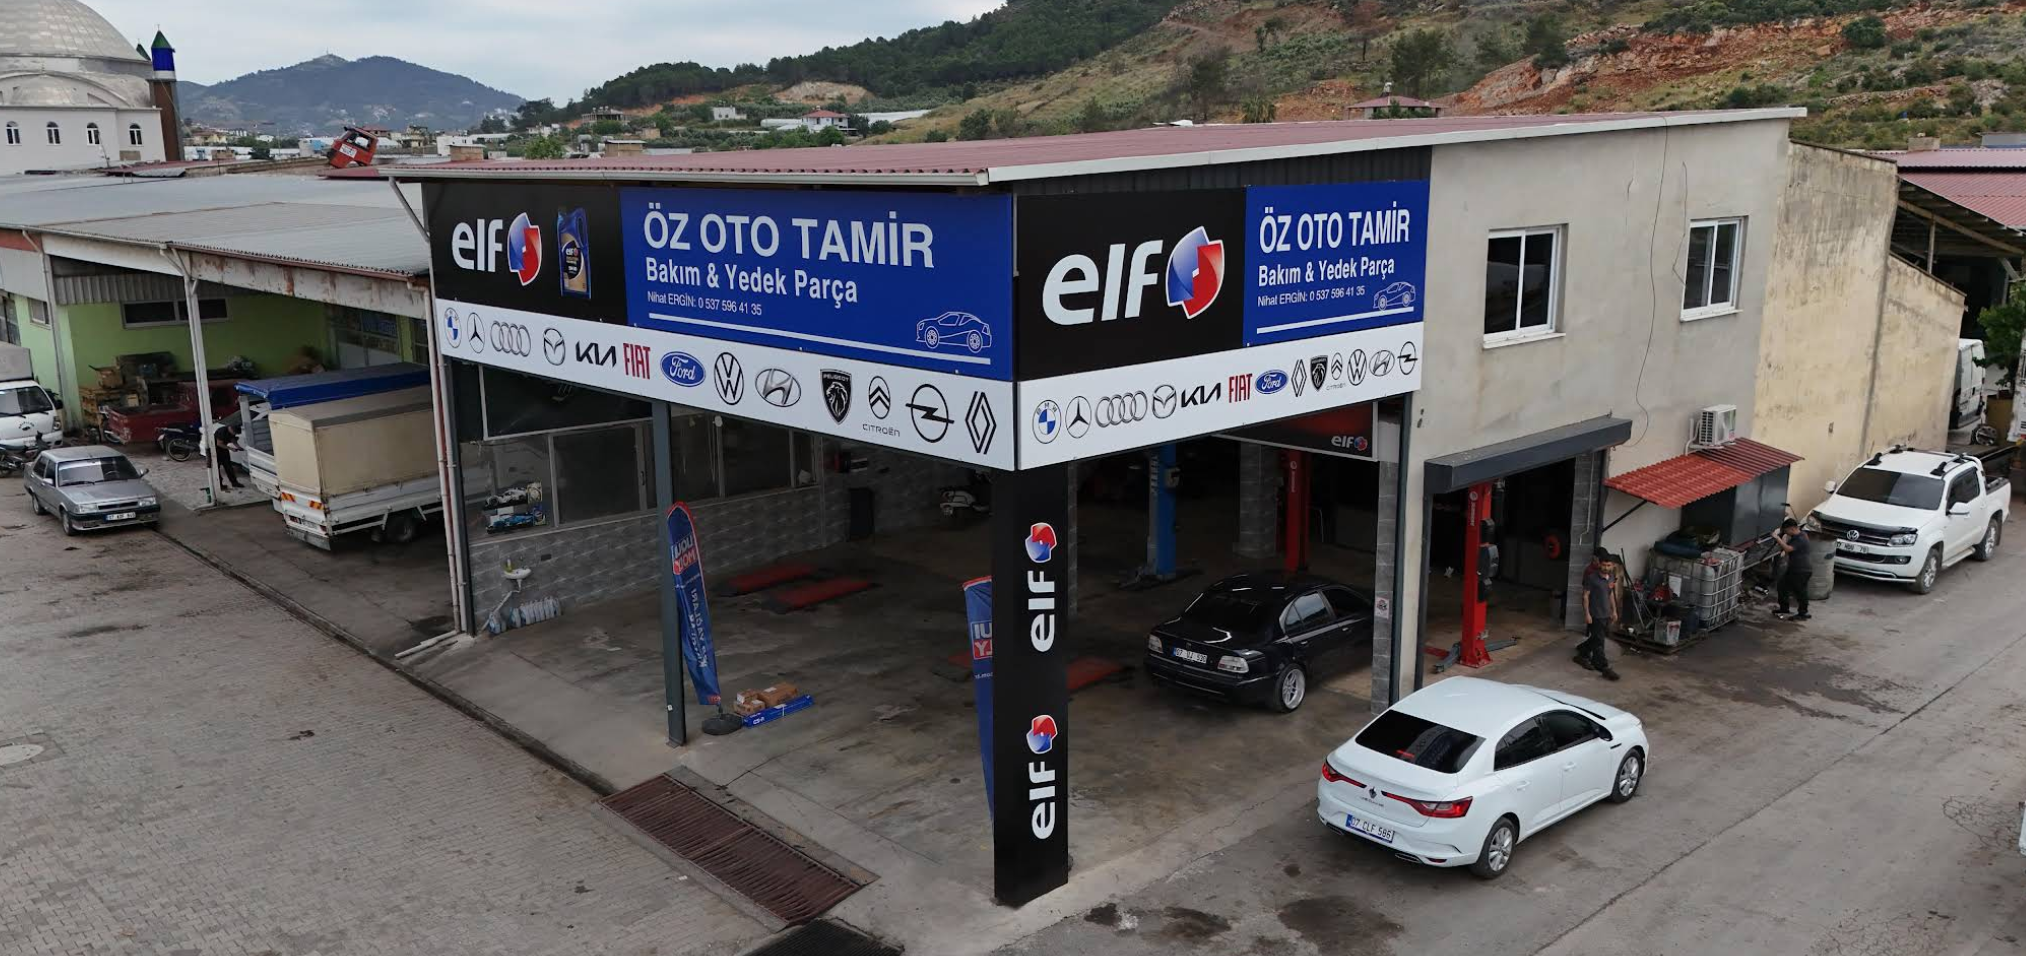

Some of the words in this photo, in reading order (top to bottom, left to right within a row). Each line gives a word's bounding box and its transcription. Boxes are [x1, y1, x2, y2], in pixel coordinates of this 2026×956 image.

[644, 202, 691, 250] ÖZ
[700, 213, 779, 257] OTO
[791, 211, 935, 268] TAMİR
[1259, 206, 1292, 254] ÖZ
[1297, 211, 1343, 251] OTO
[1348, 200, 1410, 246] TAMİR
[452, 218, 503, 272] elf
[646, 256, 700, 286] Bakım
[706, 262, 720, 288] &
[724, 263, 787, 295] Yedek
[794, 269, 858, 309] Parça
[1042, 239, 1163, 326] elf
[1258, 264, 1301, 287] Bakım
[1305, 261, 1314, 283] &
[1318, 258, 1357, 281] Yedek
[1360, 256, 1395, 280] Parça
[647, 291, 667, 304] Nihat
[697, 297, 704, 309] 0
[705, 298, 720, 311] 537
[721, 299, 737, 313] 596
[738, 301, 748, 314] 41
[750, 303, 762, 316] 35
[1257, 295, 1278, 307] Nihat
[1309, 290, 1315, 301] 0
[1316, 289, 1329, 301] 537
[1330, 287, 1344, 299] 596
[1345, 286, 1354, 297] 41
[1356, 285, 1365, 296] 35
[575, 341, 617, 367] KIA
[622, 342, 651, 380] FIAT
[669, 356, 696, 380] Ford
[1180, 382, 1221, 408] KIA
[1228, 373, 1253, 403] FIAT
[1261, 373, 1282, 390] Ford
[1331, 435, 1354, 448] elf
[1027, 570, 1055, 652] elf
[1028, 761, 1055, 839] elf
[1362, 820, 1376, 832] CLF
